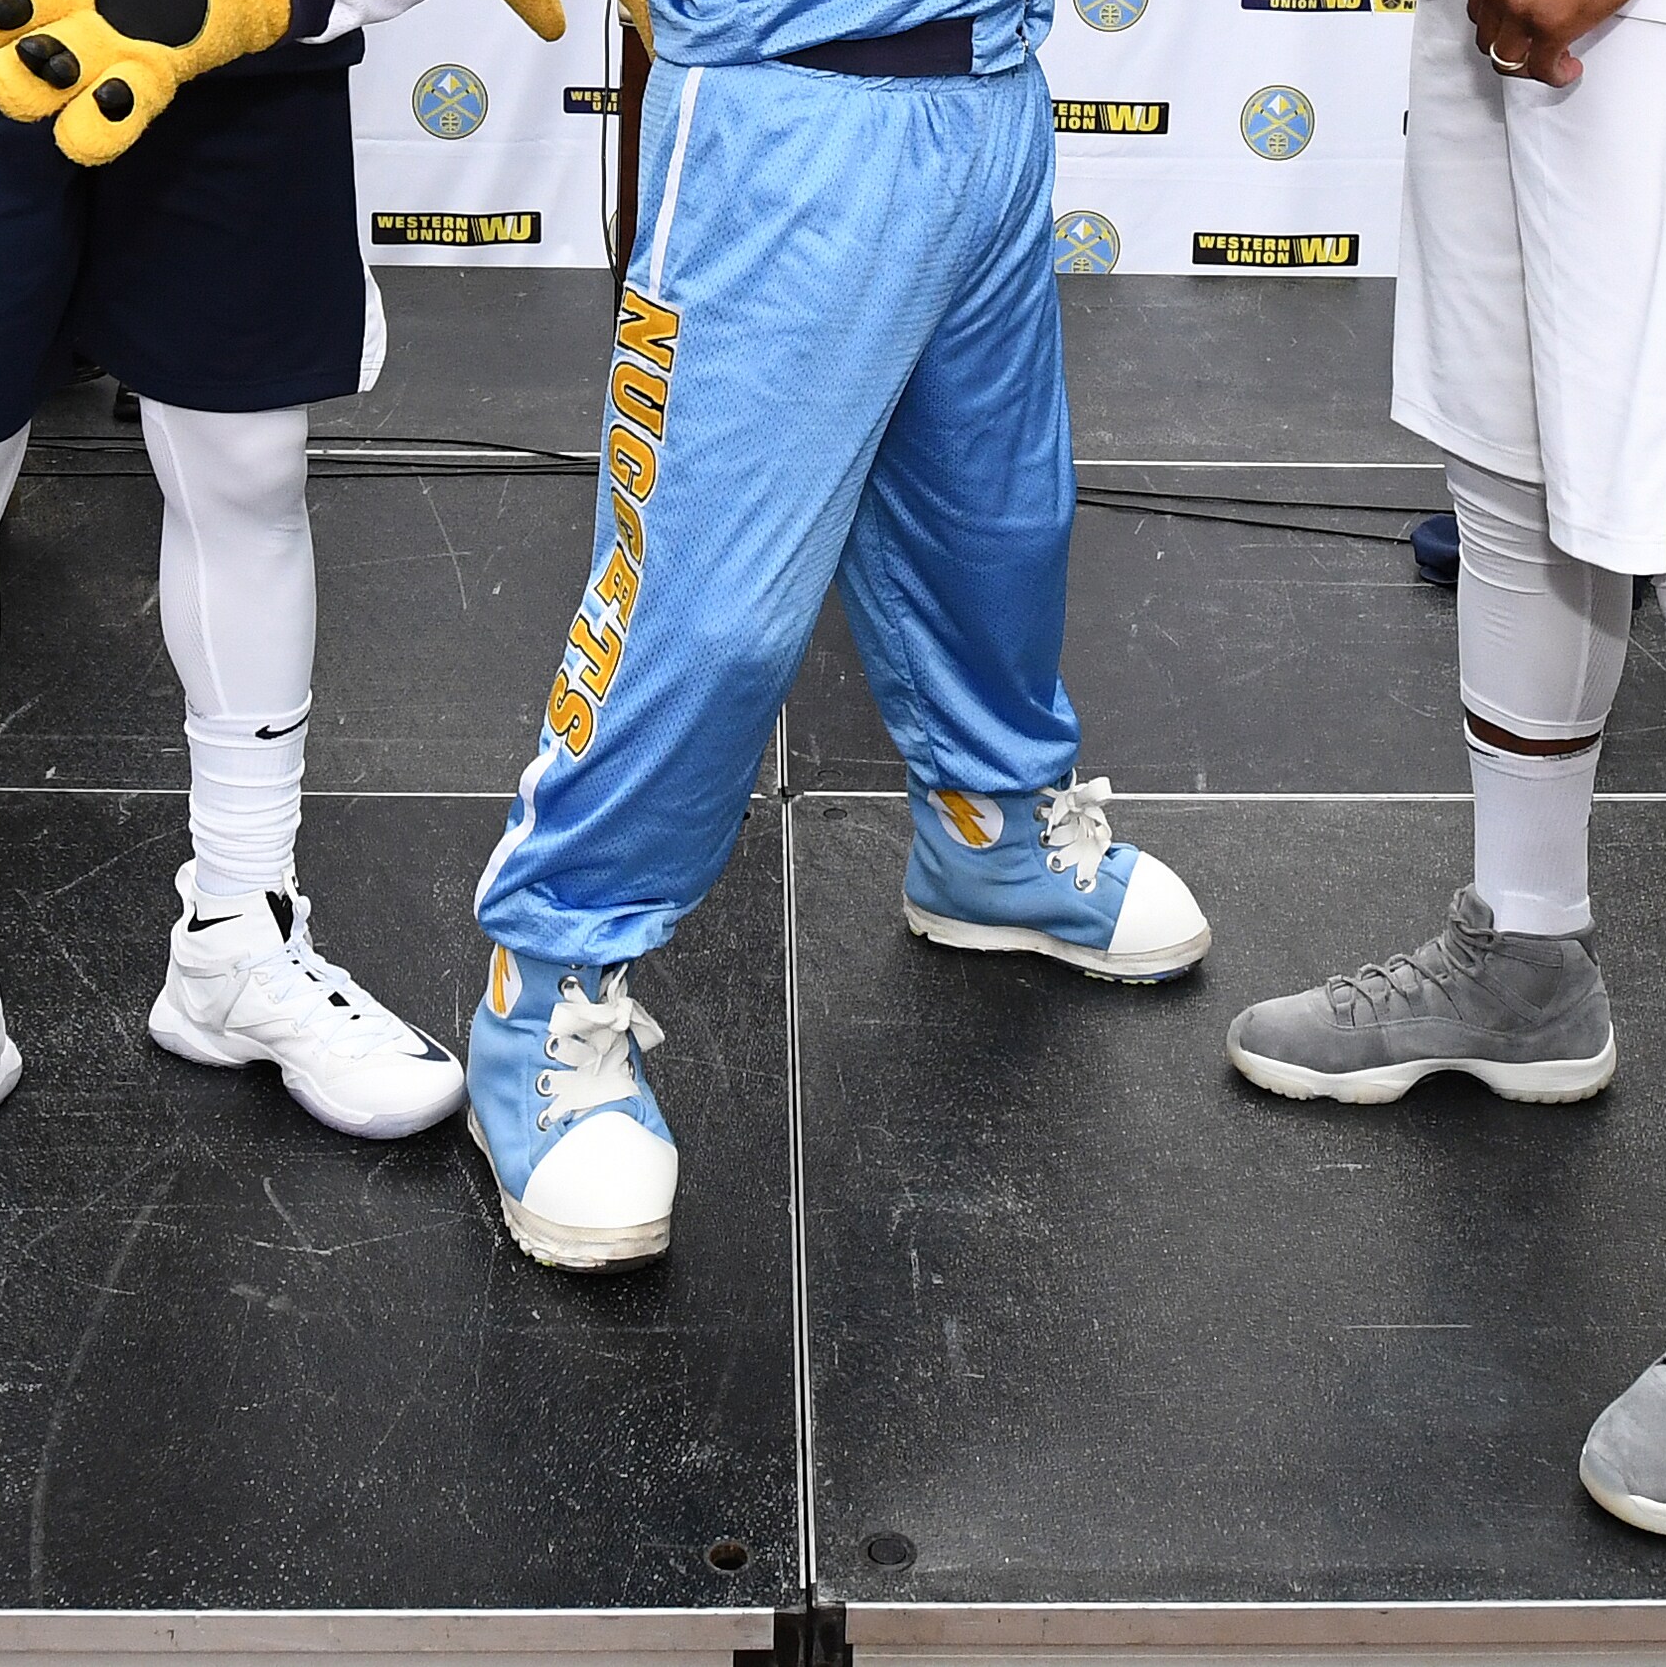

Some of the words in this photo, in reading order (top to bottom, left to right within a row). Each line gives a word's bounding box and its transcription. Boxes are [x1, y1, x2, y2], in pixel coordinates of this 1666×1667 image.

[1106, 105, 1160, 132] WU
[376, 215, 469, 230] WESTERN
[479, 216, 533, 241] WU
[406, 228, 469, 243] UNION
[1198, 235, 1290, 251] WESTERN
[1298, 237, 1350, 265] WU
[1226, 249, 1290, 264] UNION
